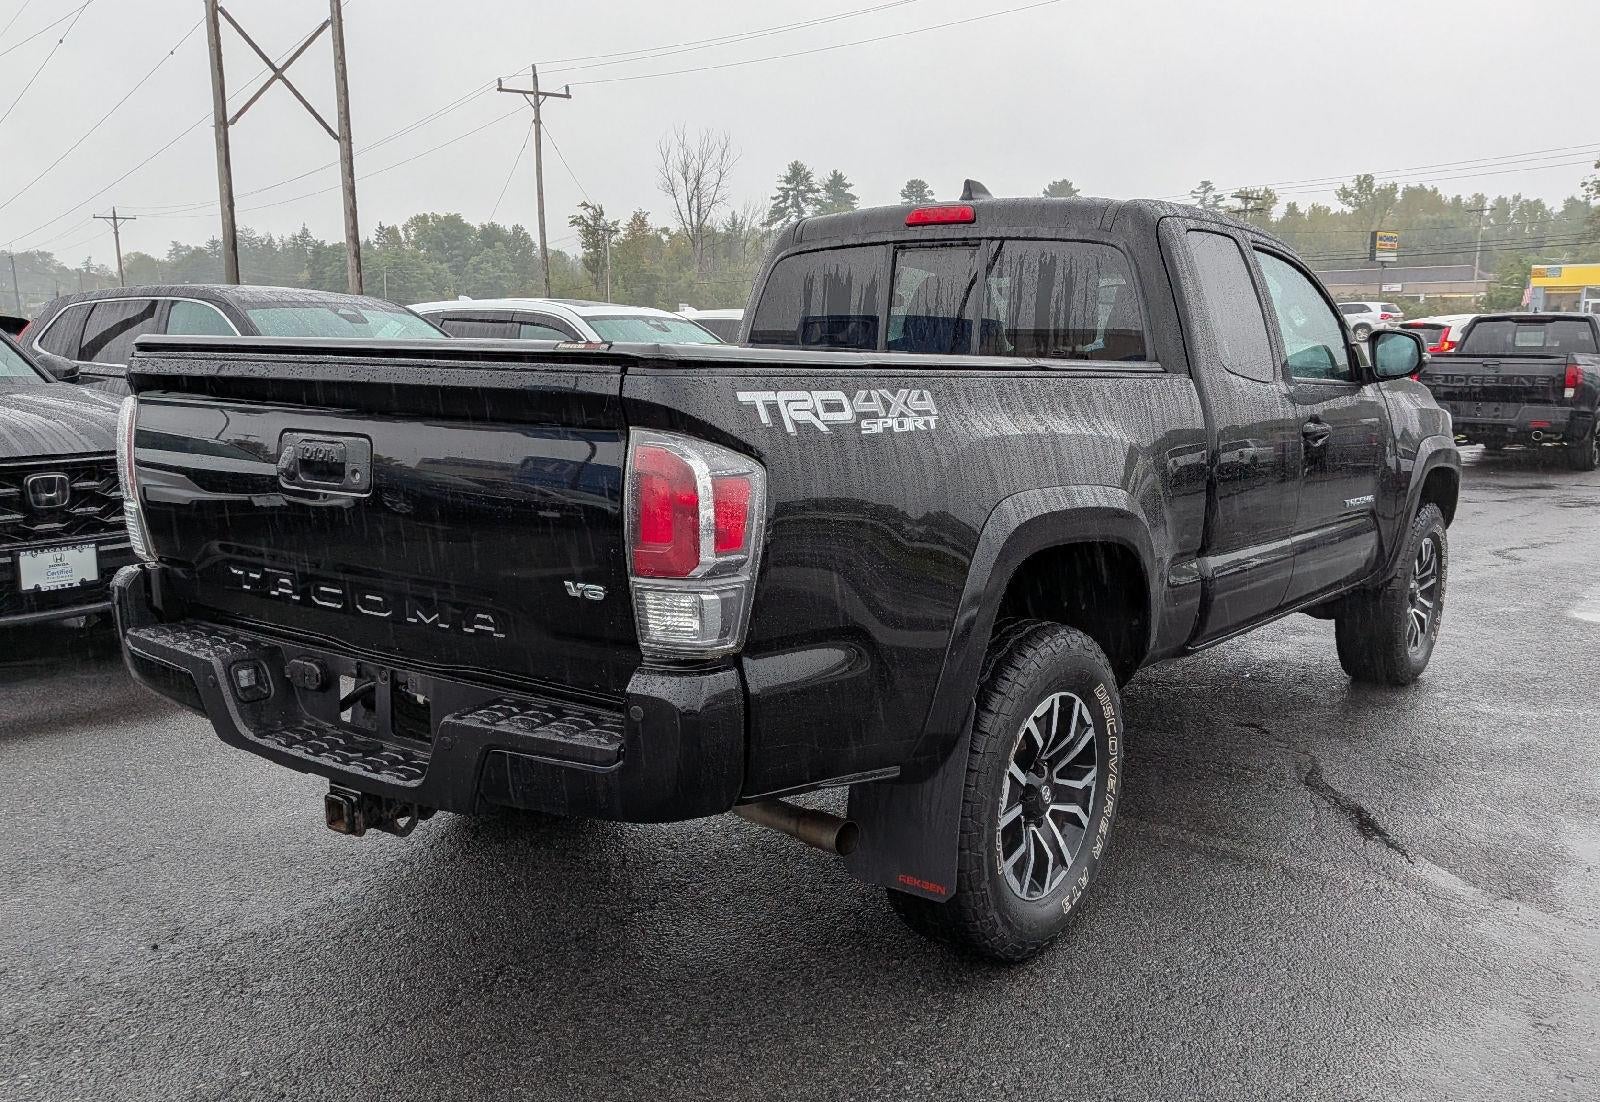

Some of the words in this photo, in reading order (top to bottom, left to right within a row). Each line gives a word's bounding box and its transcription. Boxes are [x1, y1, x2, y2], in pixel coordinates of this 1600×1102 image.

[1432, 374, 1549, 387] RIDGELINE
[736, 391, 856, 436] TRD
[852, 389, 938, 418] 4X4
[861, 415, 939, 435] SPORT
[46, 567, 74, 577] Certified
[563, 580, 608, 601] V6
[229, 566, 506, 639] TACOMA
[1092, 683, 1118, 860] DISCOVERER
